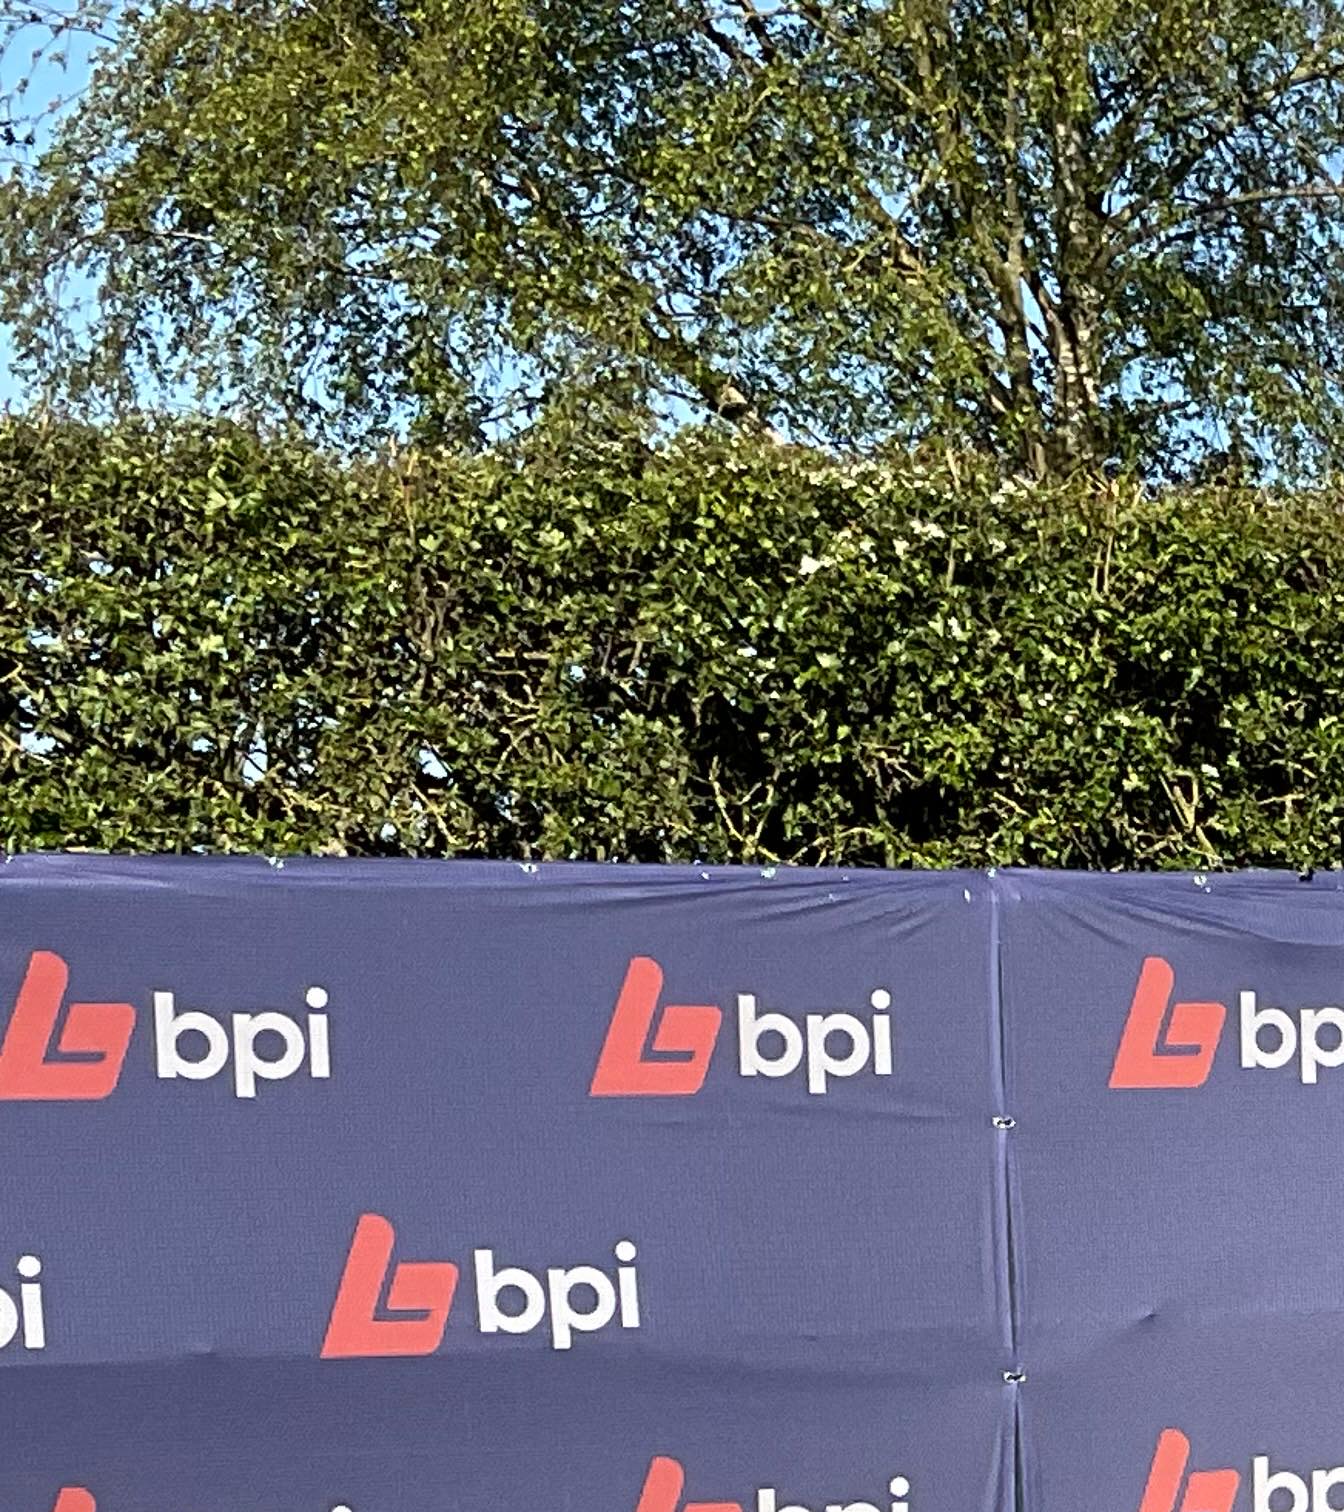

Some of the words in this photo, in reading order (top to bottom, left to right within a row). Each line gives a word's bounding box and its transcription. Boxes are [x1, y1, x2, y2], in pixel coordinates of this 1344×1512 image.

[154, 987, 330, 1098] bpi
[738, 989, 892, 1094] bpi
[474, 1241, 641, 1350] bpi
